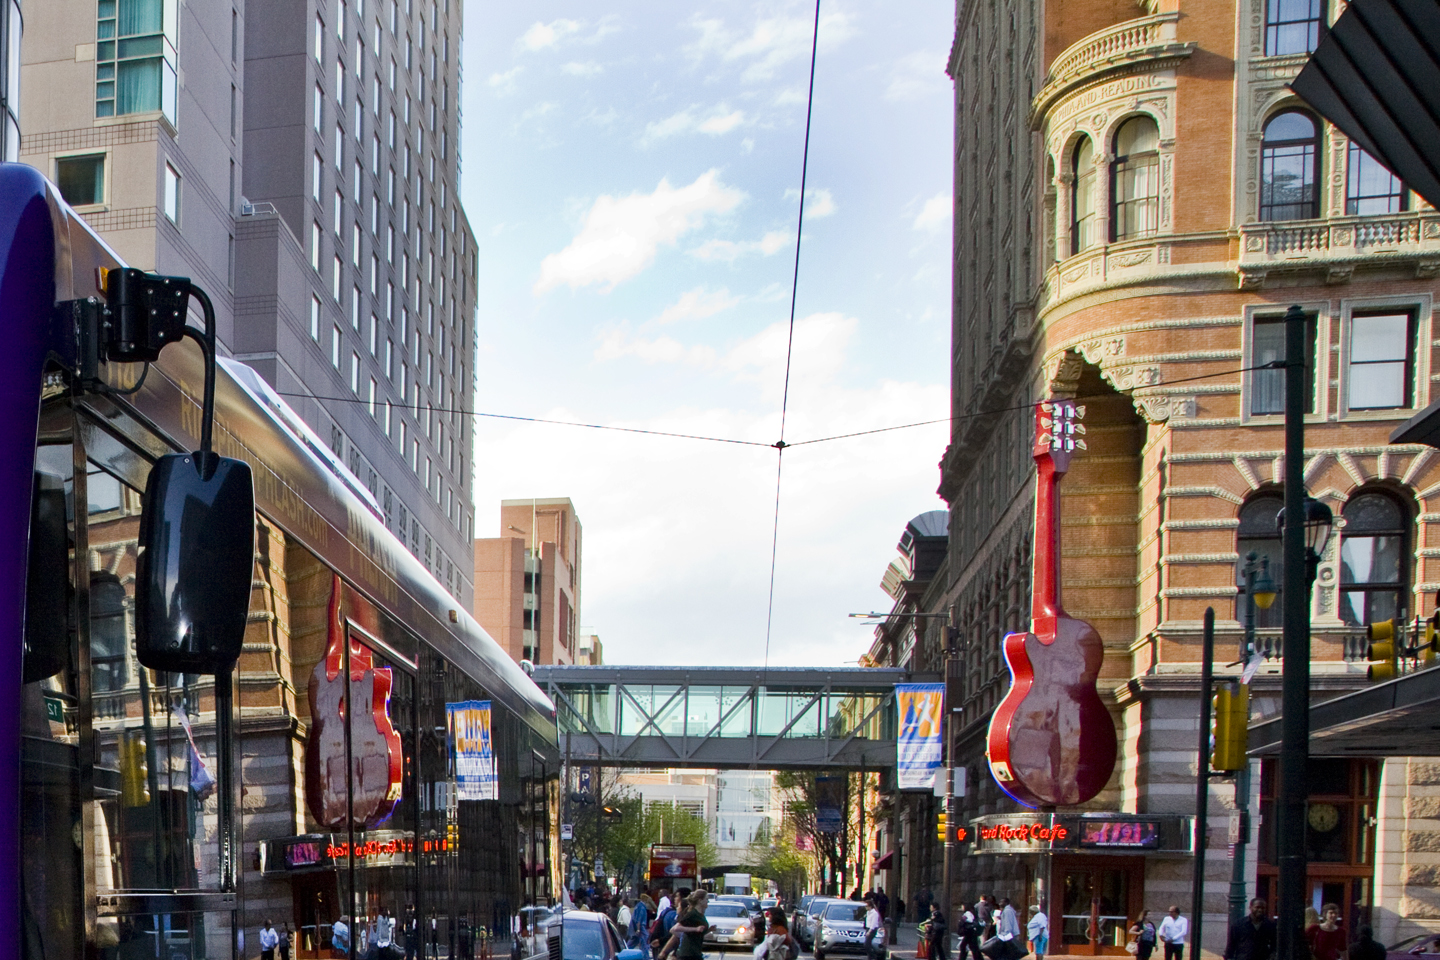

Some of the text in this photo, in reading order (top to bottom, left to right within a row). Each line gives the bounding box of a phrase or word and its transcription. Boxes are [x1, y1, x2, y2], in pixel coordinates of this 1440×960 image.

[1076, 92, 1097, 111] AND
[1101, 75, 1159, 98] READING
[981, 823, 1068, 842] ard Rock Cafe
